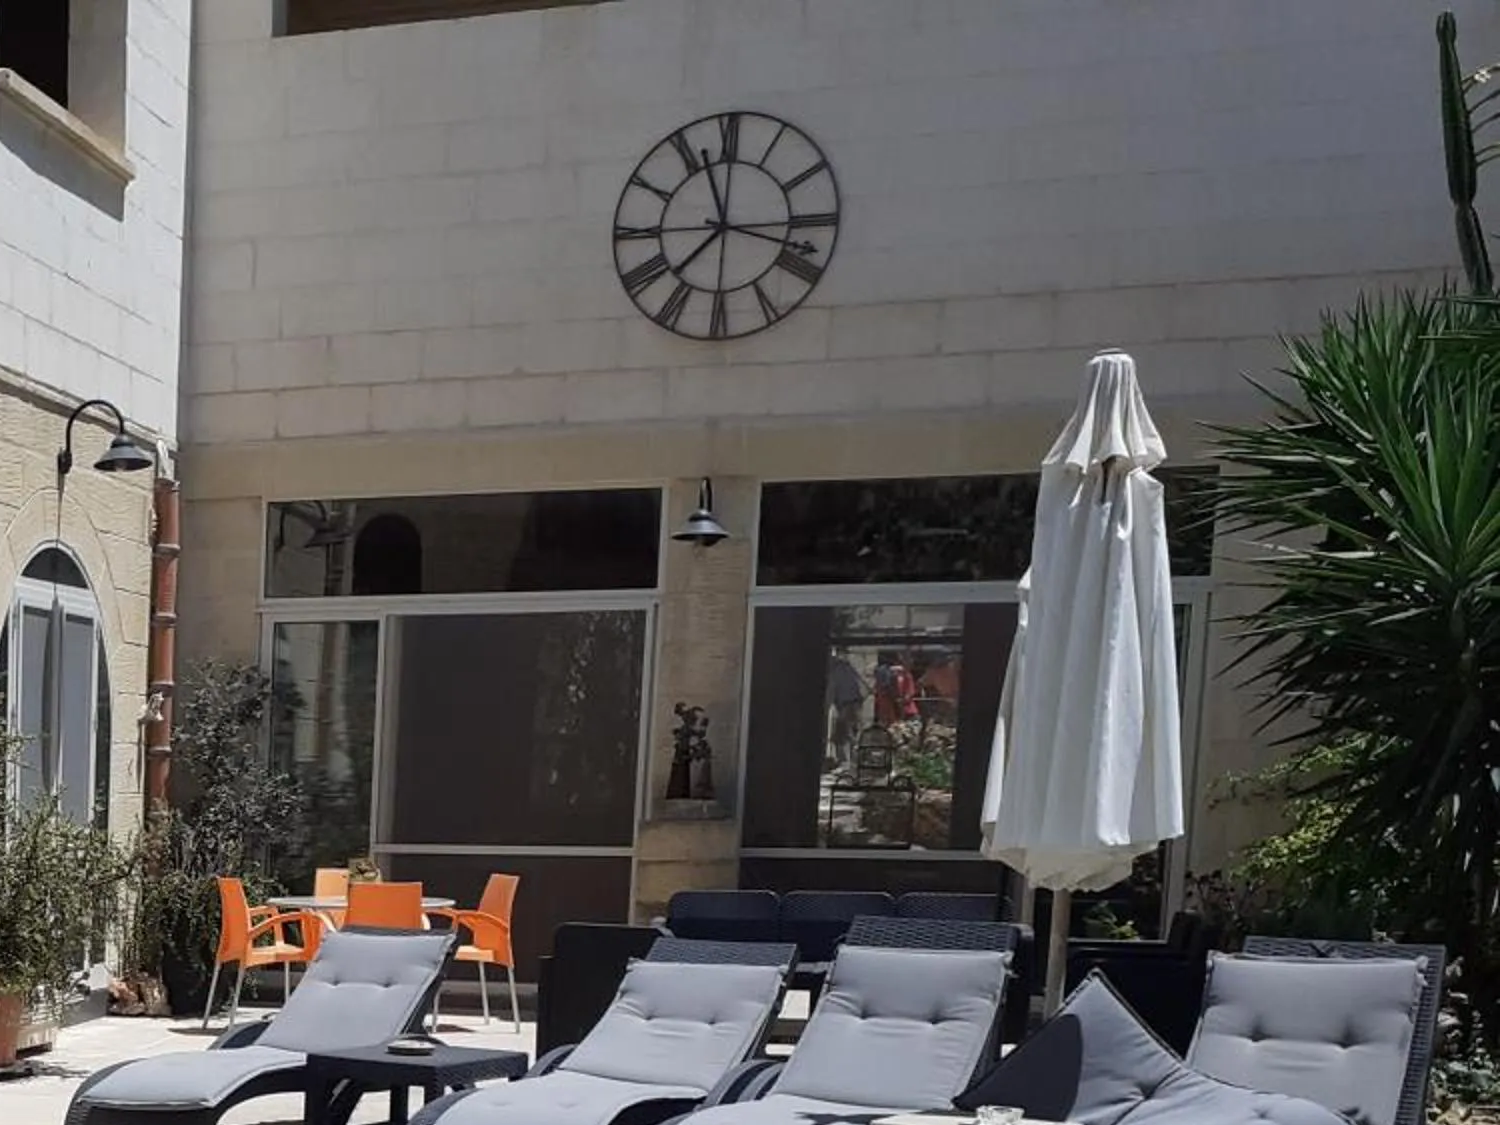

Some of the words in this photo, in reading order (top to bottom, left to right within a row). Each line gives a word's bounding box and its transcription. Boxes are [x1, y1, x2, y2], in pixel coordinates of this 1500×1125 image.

[718, 114, 741, 162] XII
[759, 125, 788, 167] I
[631, 174, 674, 203] X
[753, 283, 780, 325] V
